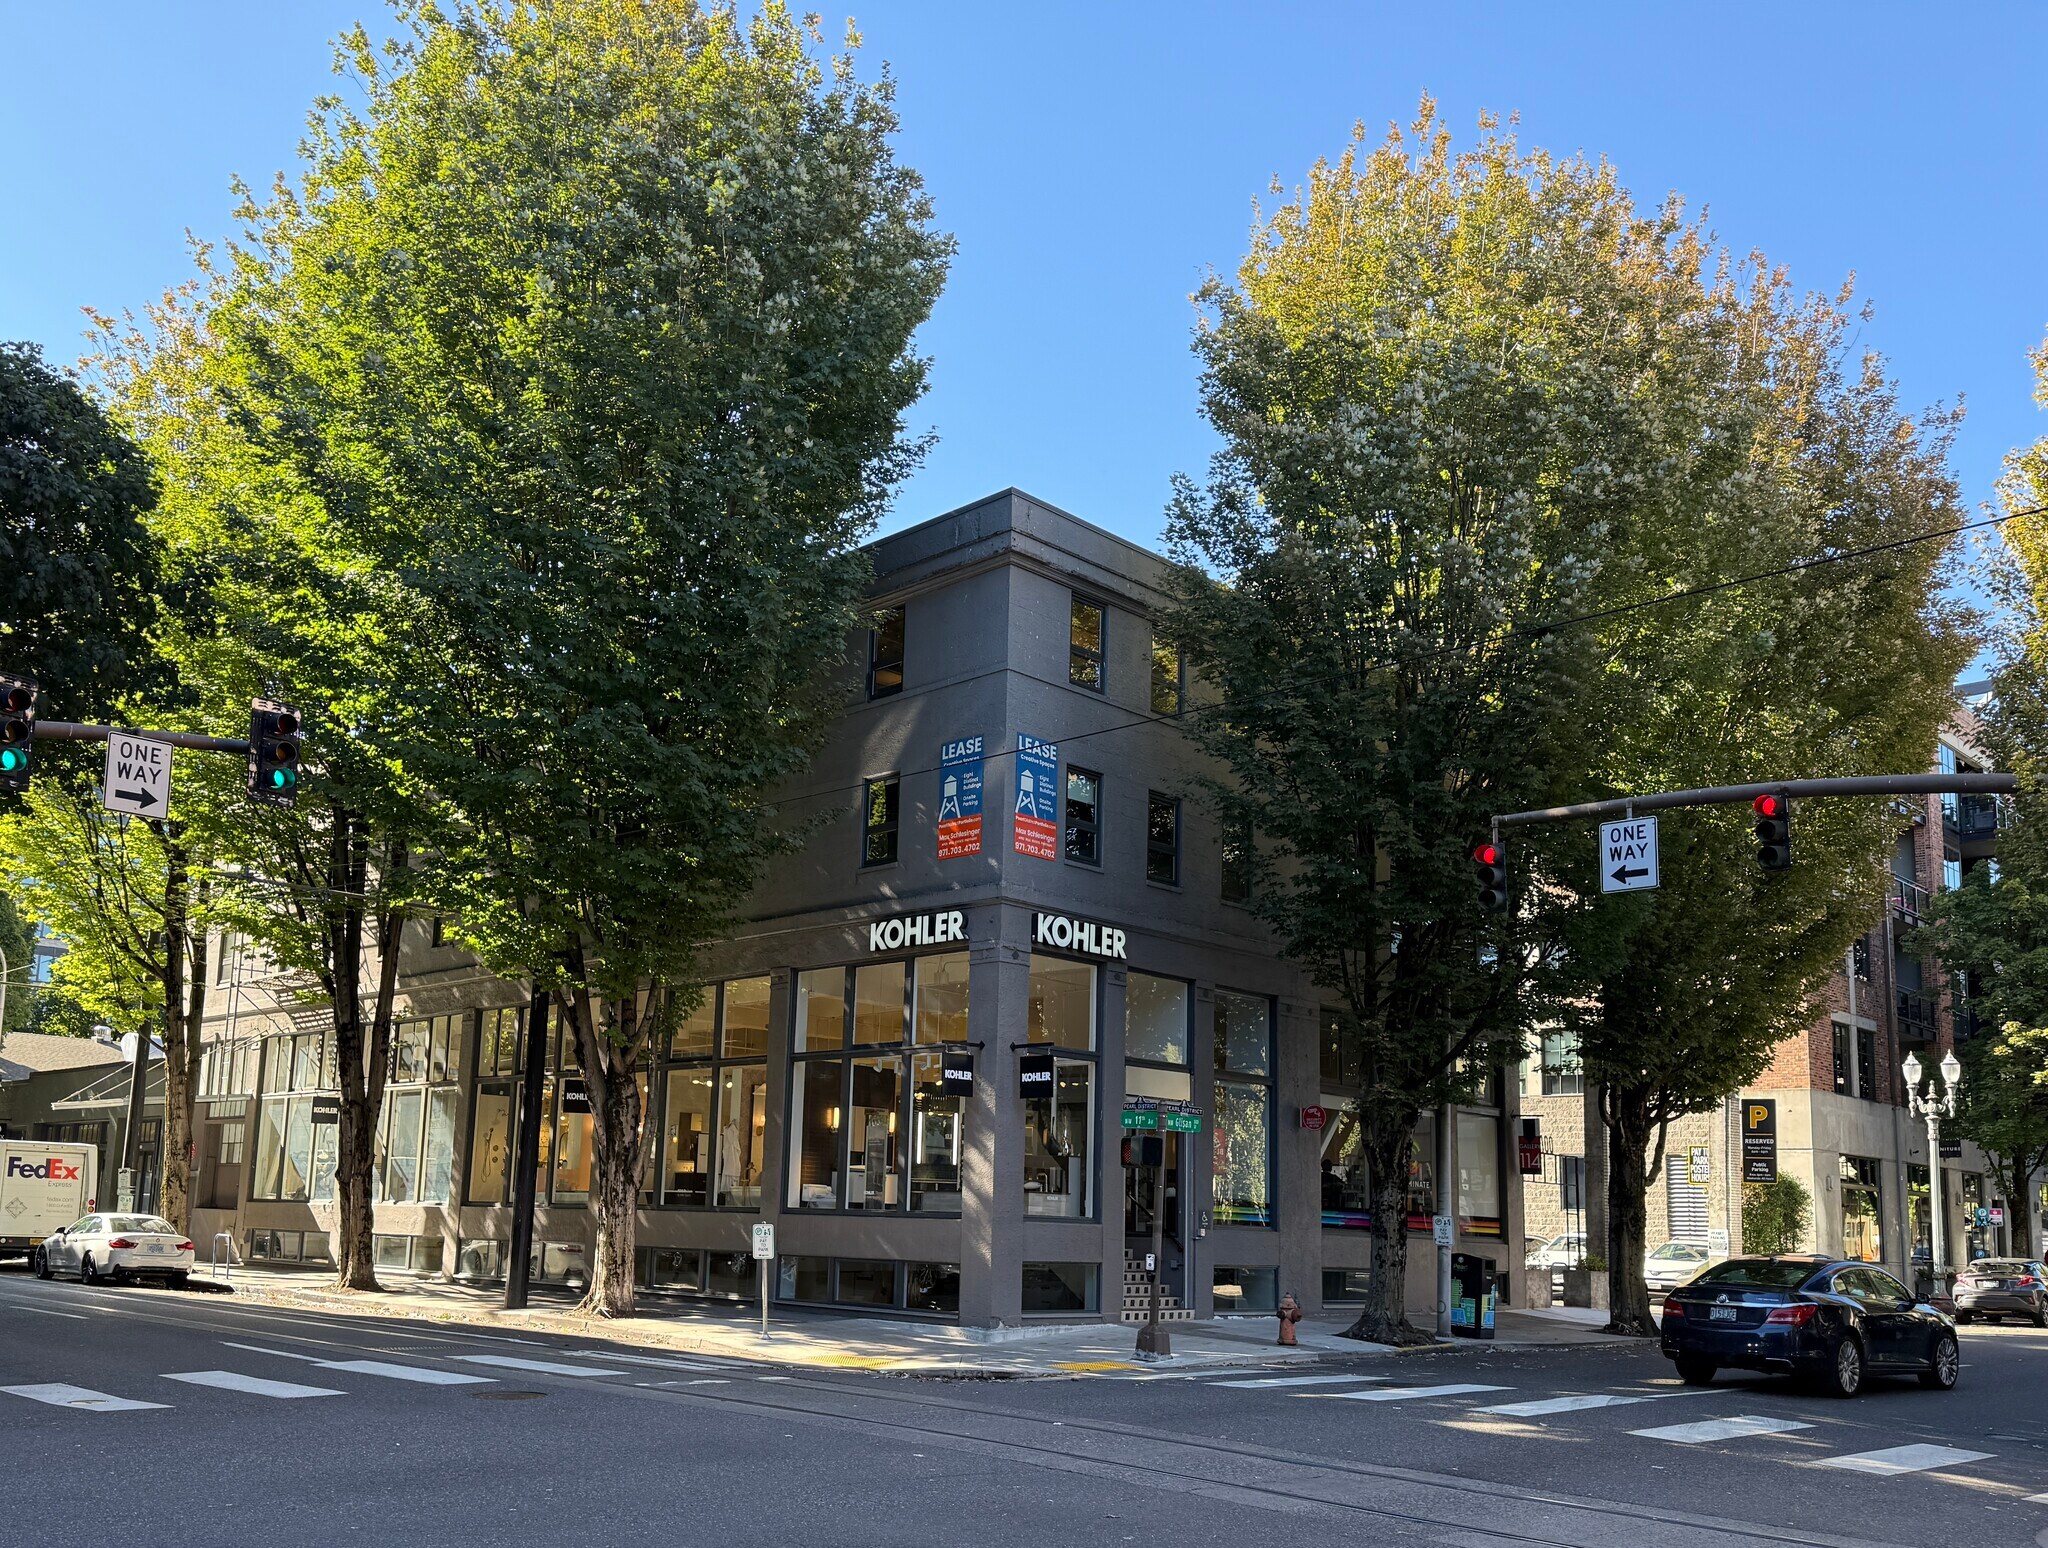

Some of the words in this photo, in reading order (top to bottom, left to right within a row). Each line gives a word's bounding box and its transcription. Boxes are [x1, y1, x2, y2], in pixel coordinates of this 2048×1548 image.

[120, 741, 162, 765] ONE
[942, 737, 983, 760] LEASE
[1018, 735, 1057, 761] LEASE
[1021, 754, 1039, 764] Creative
[1039, 760, 1055, 769] Spaces
[117, 761, 162, 785] WAY
[963, 782, 982, 790] Buildings
[1610, 824, 1647, 843] ONE
[938, 842, 980, 857] 971.703.4702
[1014, 841, 1055, 859] 971.703.4702
[1609, 842, 1649, 862] WAY
[869, 910, 965, 952] KOHLER
[1036, 912, 1128, 960] KOHLER
[945, 1069, 973, 1081] KOHLER
[1021, 1071, 1052, 1083] KOHLER
[566, 1092, 588, 1101] KOHL
[313, 1106, 338, 1115] KOHLER
[1749, 1105, 1768, 1129] P
[1175, 1117, 1192, 1129] Glisan
[7, 1156, 80, 1180] FedEx
[1520, 1152, 1540, 1169] 114
[1691, 1164, 1708, 1173] POSTE
[47, 1180, 72, 1188] Express
